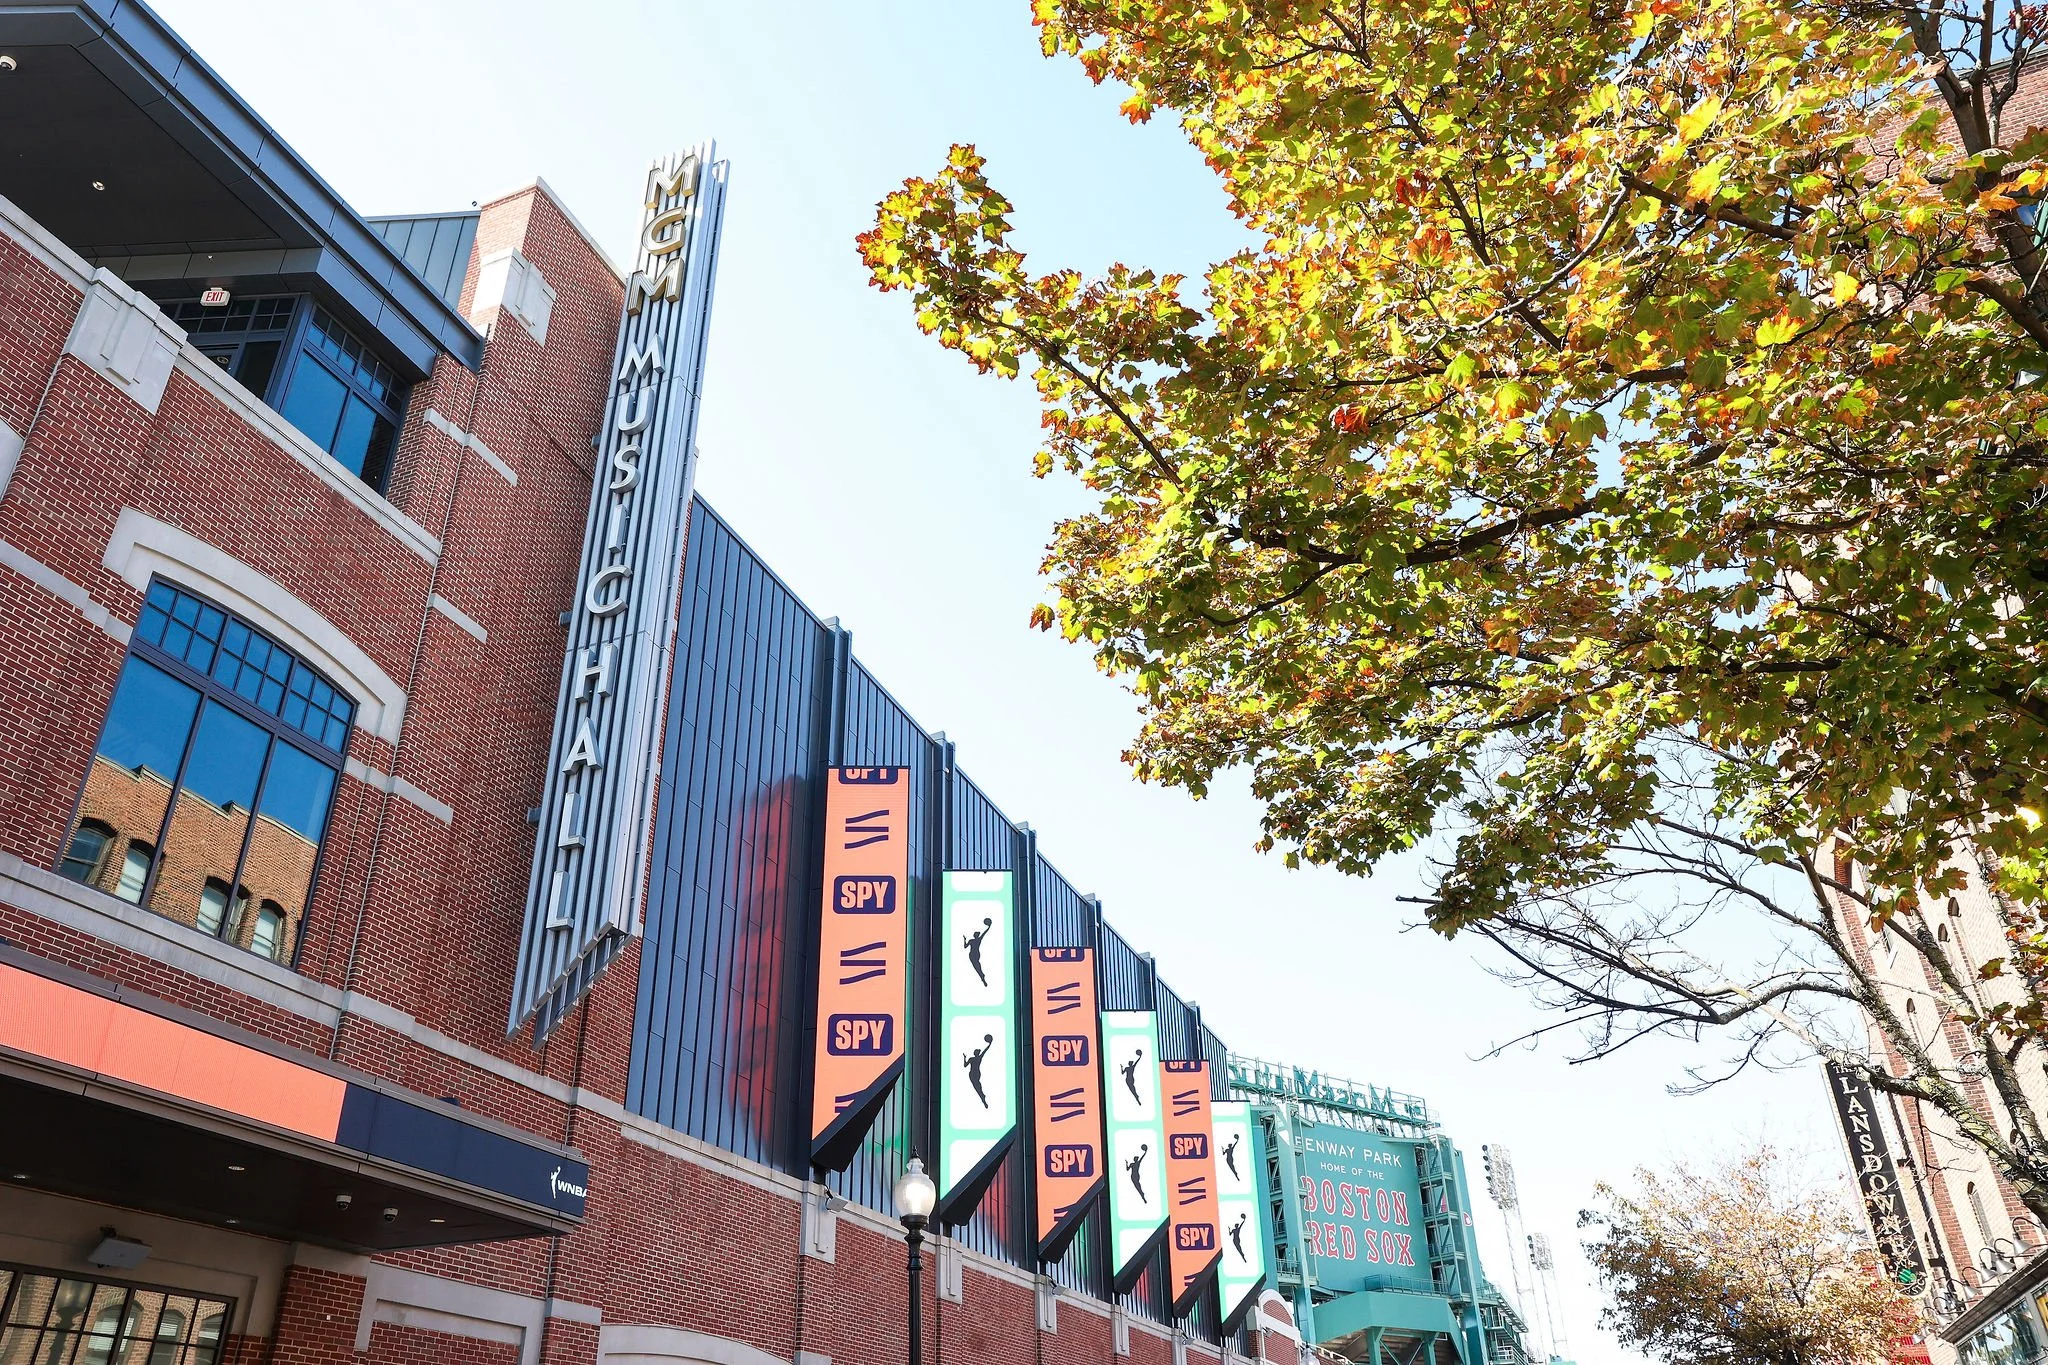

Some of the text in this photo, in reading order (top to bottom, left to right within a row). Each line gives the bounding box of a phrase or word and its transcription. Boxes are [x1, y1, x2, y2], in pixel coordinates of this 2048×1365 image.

[205, 291, 225, 302] EXIT
[546, 154, 699, 931] MGM MUSIC HALL
[840, 880, 889, 909] SPY
[835, 1020, 885, 1050] SPY
[1047, 1039, 1083, 1063] SPY
[1174, 1137, 1204, 1156] SPY
[1363, 1148, 1402, 1168] PARK
[1051, 1149, 1088, 1173] SPY
[1320, 1161, 1384, 1180] HOME OF THE
[1300, 1175, 1410, 1226] BOSTON
[1180, 1227, 1210, 1247] SPY
[1305, 1220, 1416, 1266] RED SOX
